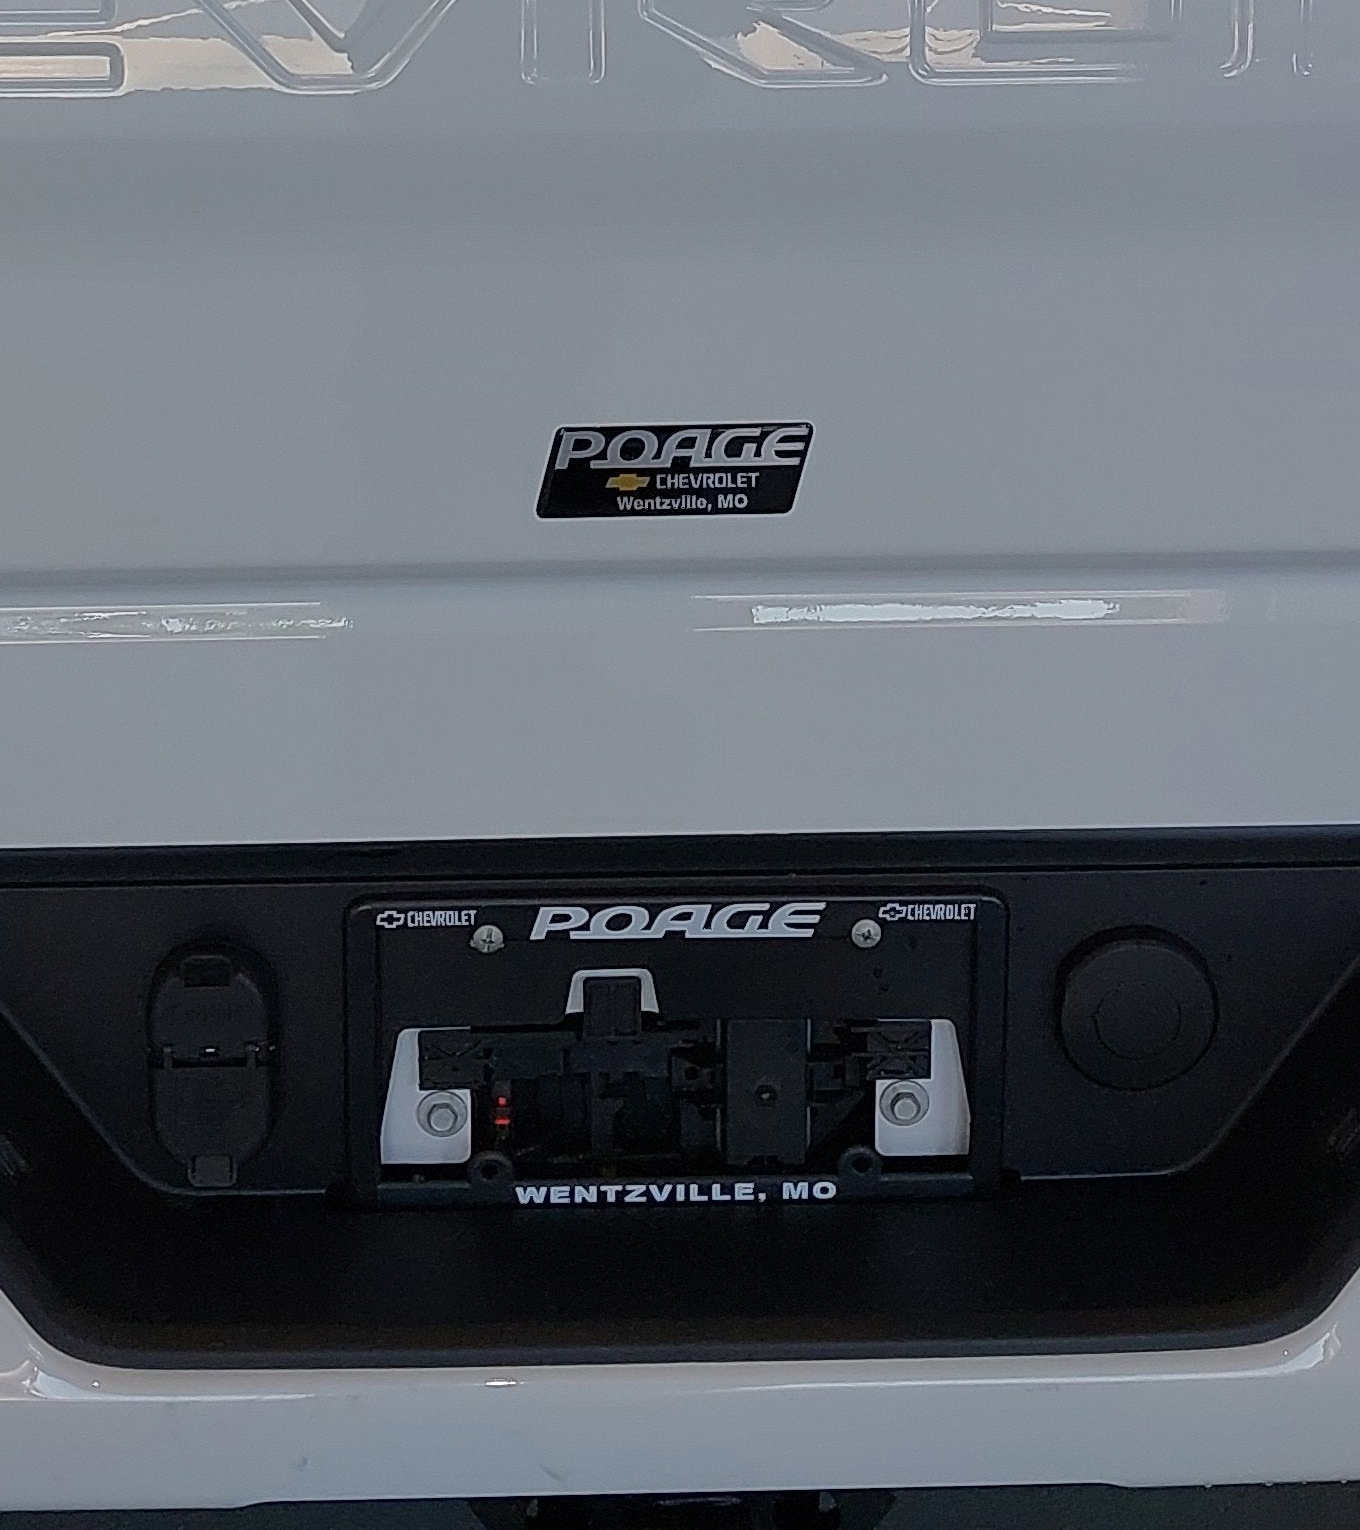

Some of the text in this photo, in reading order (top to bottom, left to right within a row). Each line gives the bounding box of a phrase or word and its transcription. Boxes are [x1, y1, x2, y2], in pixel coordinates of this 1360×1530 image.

[554, 427, 810, 470] POAGE
[655, 471, 760, 490] CHEVROLET
[616, 492, 748, 512] Wentzville, MO
[406, 909, 478, 928] CHEVROLET
[529, 901, 827, 940] POAGE
[906, 903, 977, 921] CHEVROLET
[514, 1181, 837, 1205] WENTZVILLE, MO
